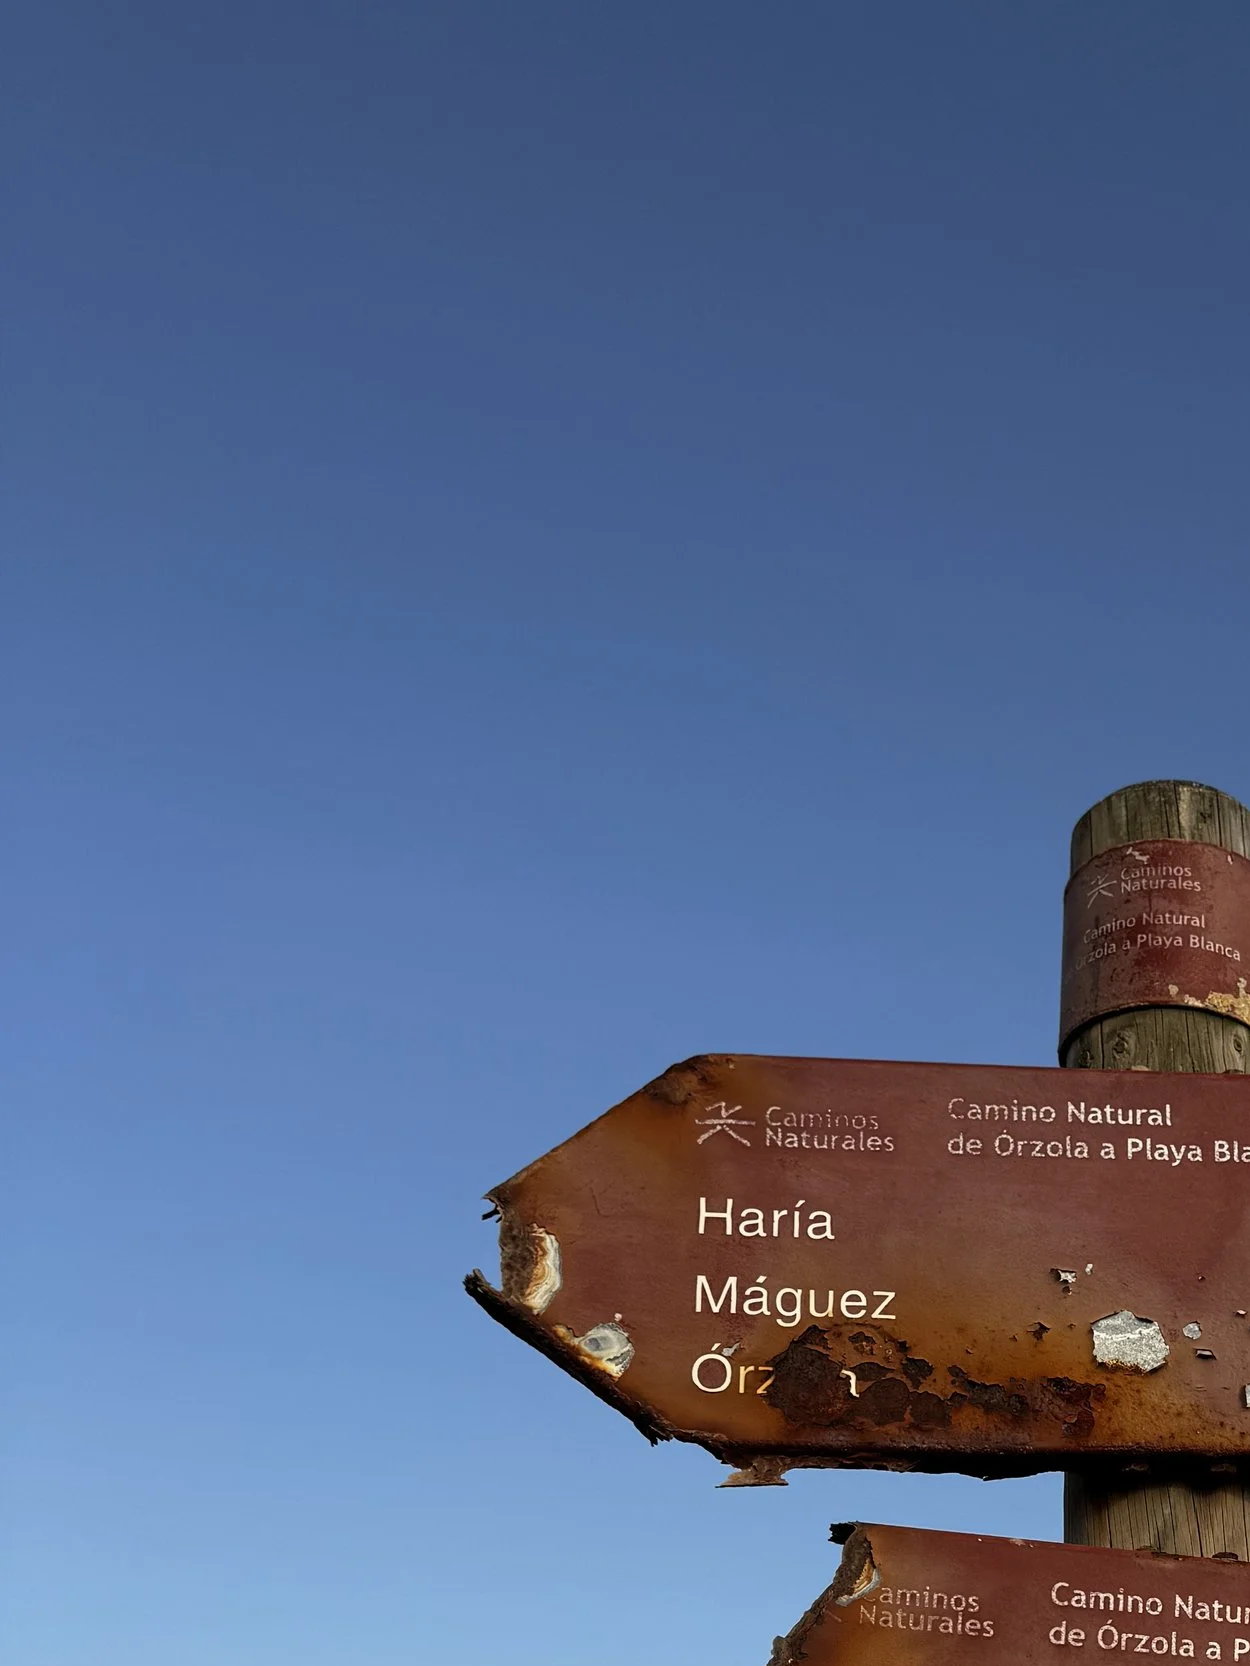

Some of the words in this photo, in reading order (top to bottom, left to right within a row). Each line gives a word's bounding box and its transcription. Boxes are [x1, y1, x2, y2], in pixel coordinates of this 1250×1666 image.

[1120, 866, 1192, 880] Caminos
[1120, 877, 1202, 894] Naturales
[1083, 915, 1136, 944] Camino
[1142, 912, 1206, 928] Natural
[1122, 940, 1131, 951] a
[1137, 933, 1183, 950] Playa
[1189, 934, 1241, 962] Blanca
[765, 1106, 880, 1130] Caminos
[947, 1098, 1056, 1123] Camino
[1066, 1101, 1173, 1127] Natural
[765, 1127, 895, 1152] Naturales
[947, 1132, 983, 1155] de
[994, 1130, 1089, 1159] Órzola
[1100, 1142, 1116, 1160] a
[1126, 1137, 1203, 1166] Playa
[698, 1196, 836, 1240] Haría
[695, 1275, 897, 1328] Máguez
[1050, 1581, 1163, 1616] Camino
[859, 1604, 995, 1637] Naturales
[1049, 1621, 1086, 1647] de
[1096, 1619, 1195, 1657] Órzola
[1205, 1640, 1222, 1660] a
